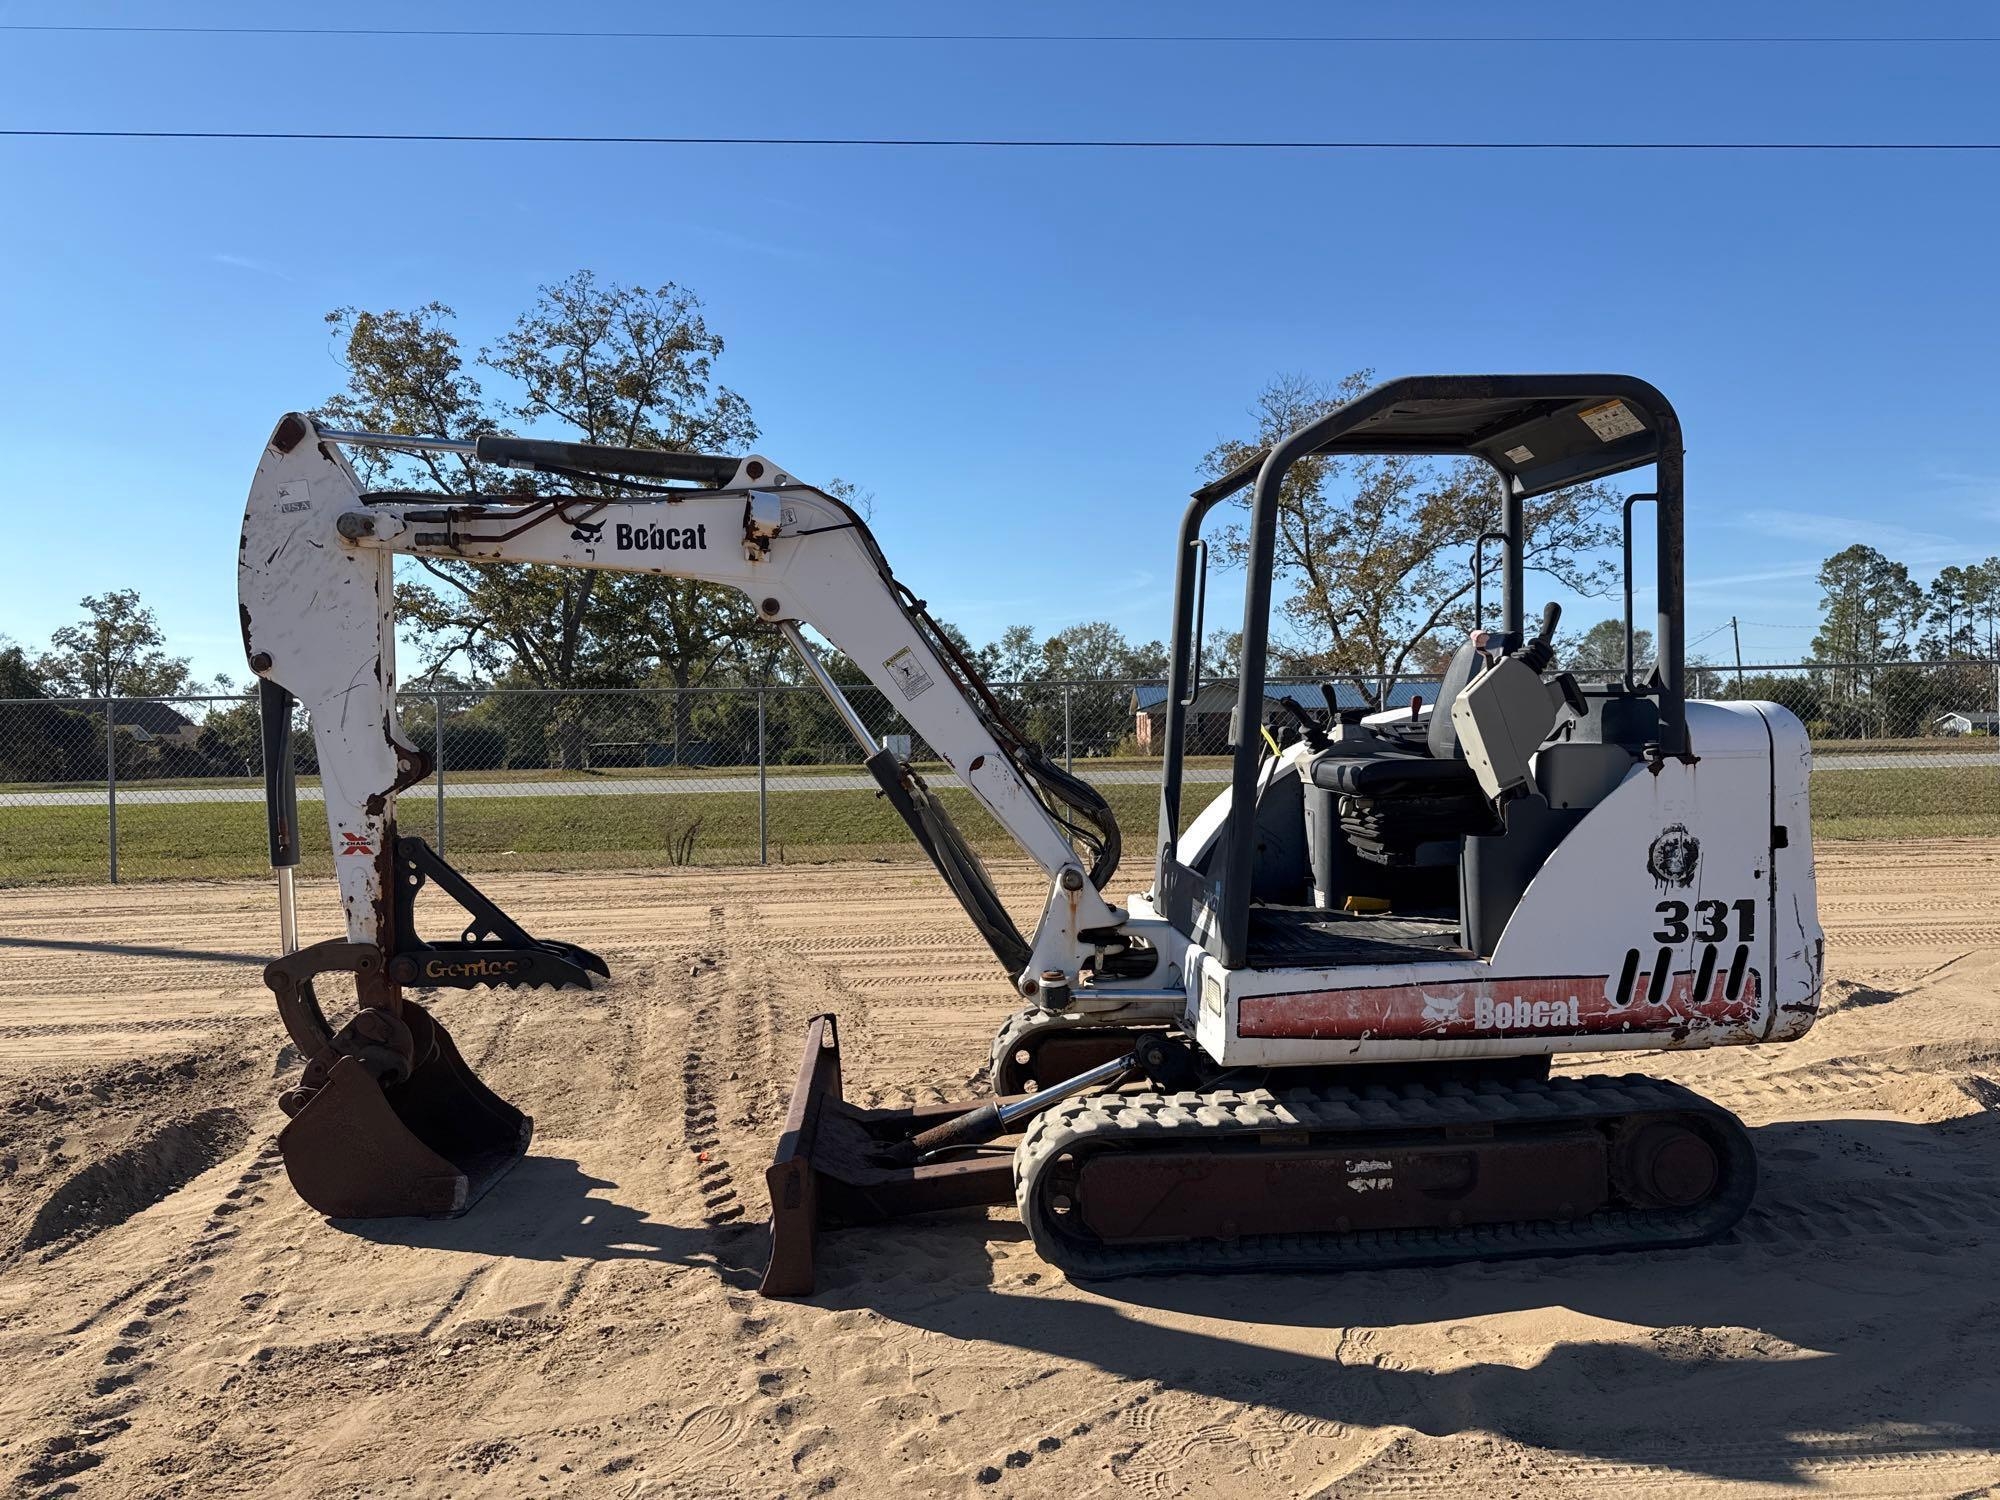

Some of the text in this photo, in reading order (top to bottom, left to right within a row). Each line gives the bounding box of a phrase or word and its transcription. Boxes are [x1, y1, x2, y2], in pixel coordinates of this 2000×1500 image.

[282, 501, 311, 514] USA
[616, 523, 707, 550] Bobcat
[1653, 899, 1755, 943] 331
[1474, 995, 1580, 1029] Bobcat
